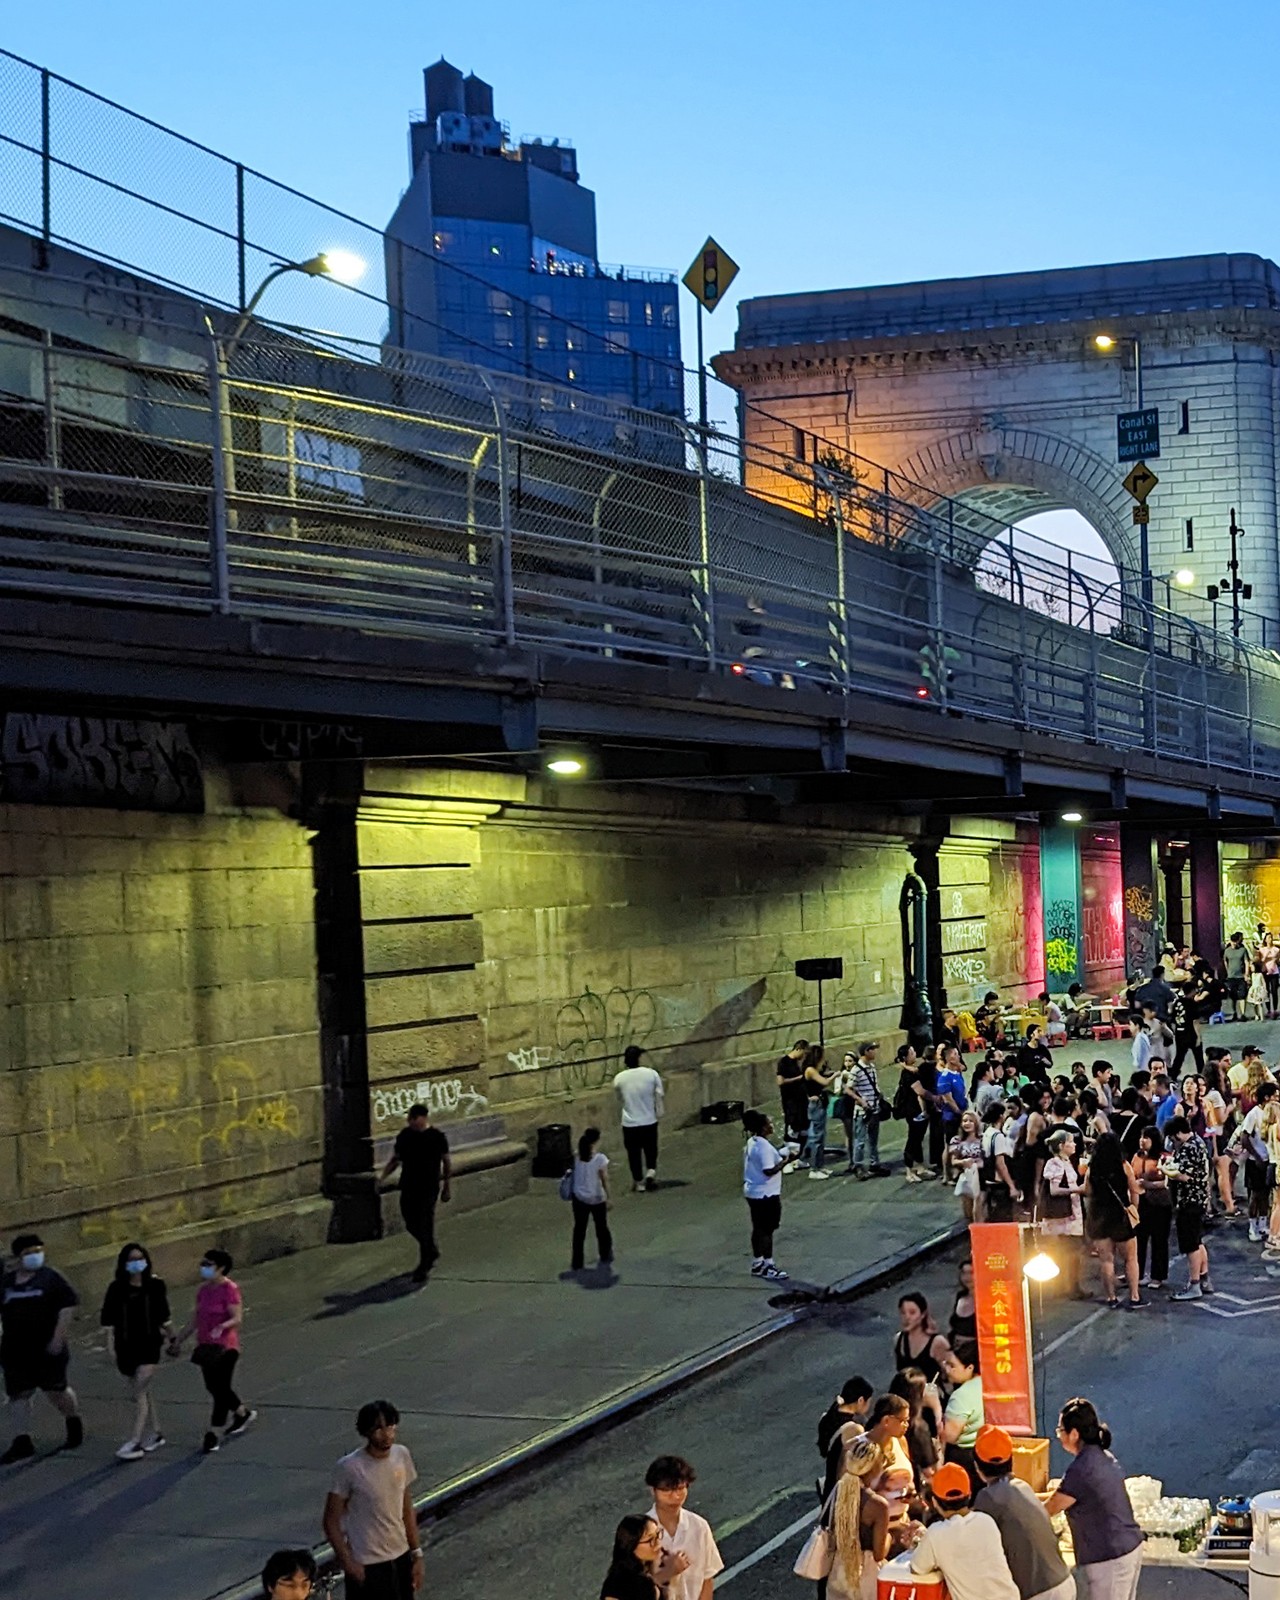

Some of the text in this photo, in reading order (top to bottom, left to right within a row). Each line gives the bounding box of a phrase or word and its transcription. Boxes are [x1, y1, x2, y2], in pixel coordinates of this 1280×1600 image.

[1119, 413, 1156, 430] Canal St
[1127, 430, 1148, 442] EAST
[1120, 441, 1159, 456] RIGHT LANE
[991, 1279, 1008, 1316] 美食
[994, 1323, 1012, 1374] EATS
